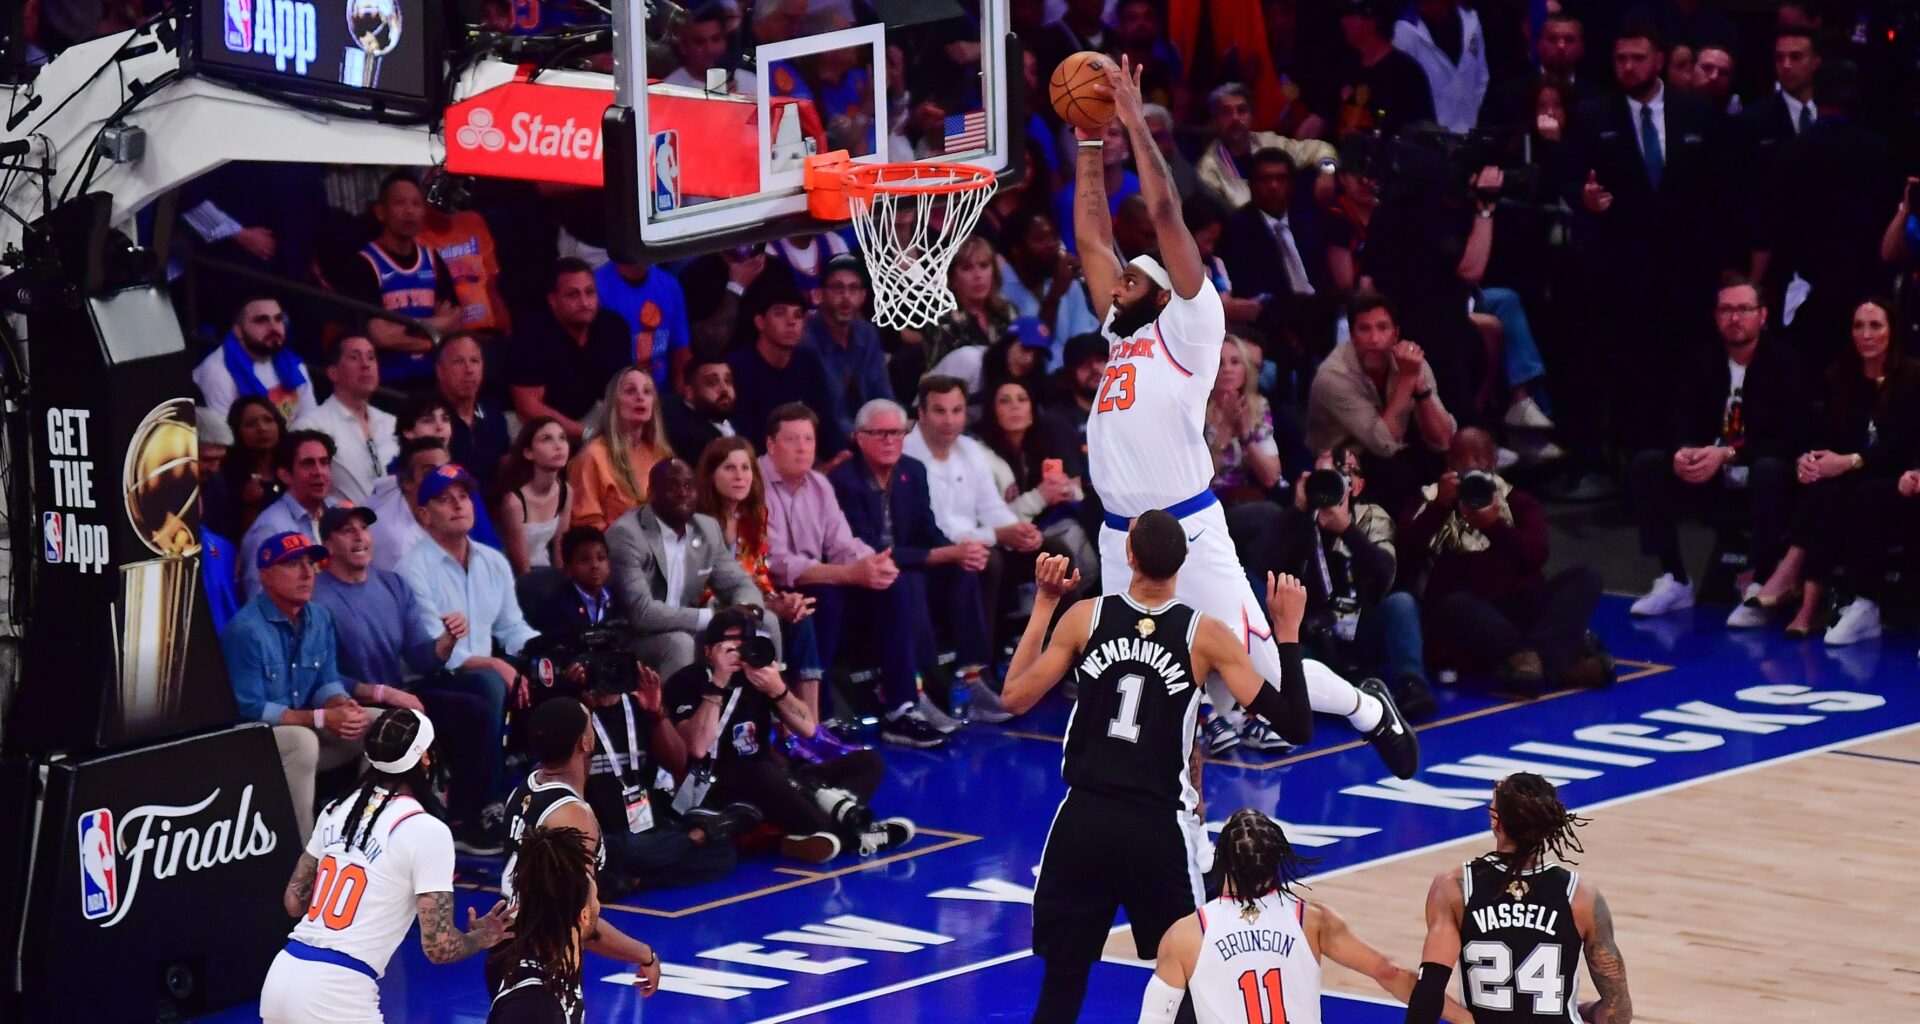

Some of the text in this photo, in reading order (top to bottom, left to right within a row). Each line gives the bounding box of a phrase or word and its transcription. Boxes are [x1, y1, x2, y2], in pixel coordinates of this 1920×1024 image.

[253, 0, 317, 75] App
[1097, 363, 1137, 414] 23
[47, 407, 90, 457] GET
[49, 460, 96, 508] THE
[64, 513, 110, 574] App
[1080, 637, 1190, 696] WEMBANYAMA
[1107, 673, 1146, 744] 1
[99, 784, 278, 928] Finals
[600, 914, 956, 1000] NEW
[1339, 684, 1887, 811] KNICKS
[308, 854, 369, 931] 00
[1472, 903, 1559, 936] VASSELL
[1215, 929, 1296, 962] BRUNSON
[1237, 967, 1290, 1024] 11
[1463, 940, 1565, 1016] 24
